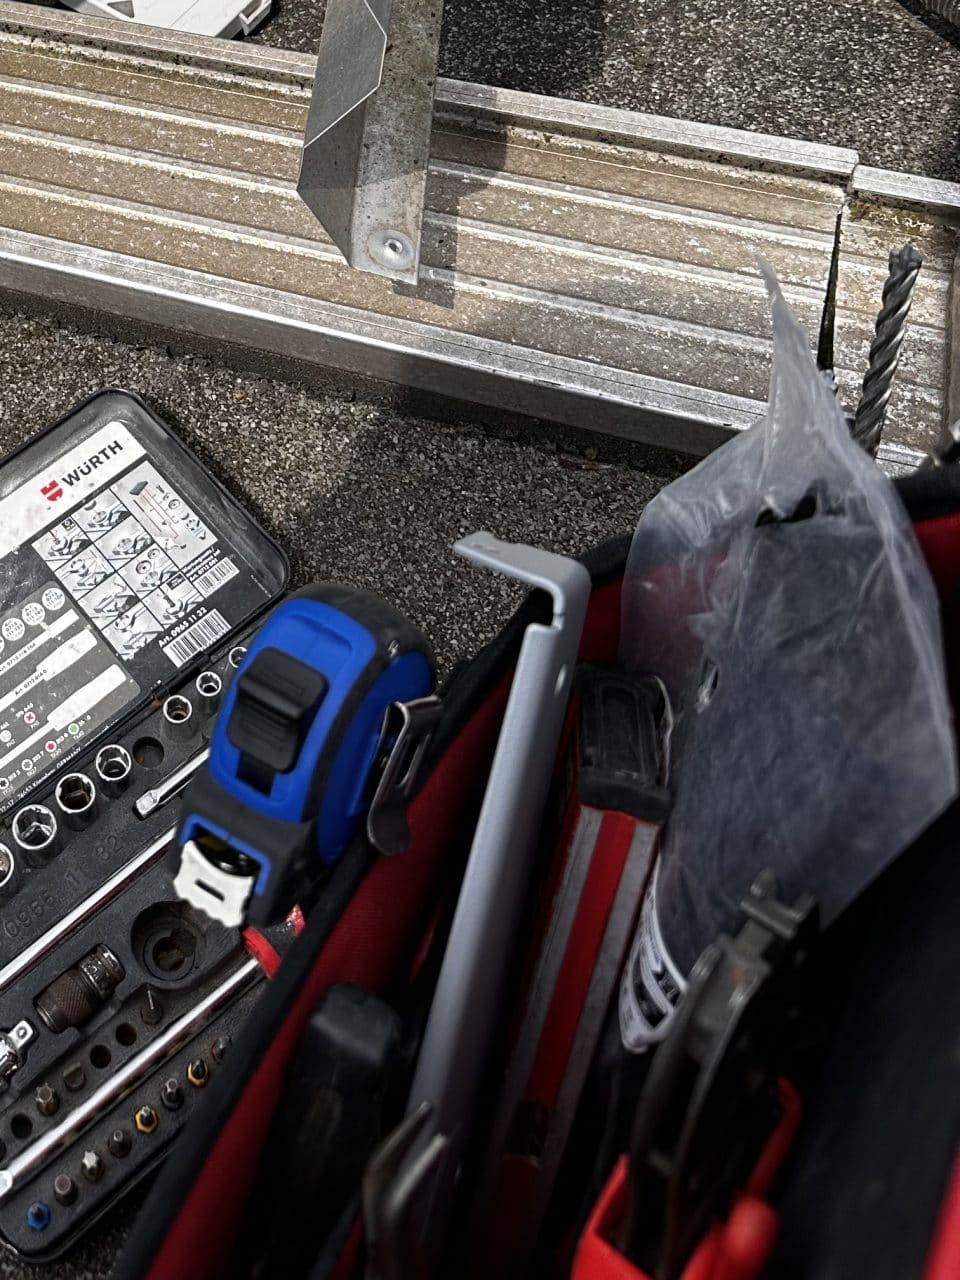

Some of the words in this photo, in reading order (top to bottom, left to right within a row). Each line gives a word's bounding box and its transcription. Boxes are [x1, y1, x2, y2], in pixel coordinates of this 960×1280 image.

[61, 438, 123, 488] WÜRTH
[157, 633, 173, 647] Art.
[169, 619, 189, 636] 0965
[187, 613, 197, 623] 11
[196, 605, 208, 617] 32
